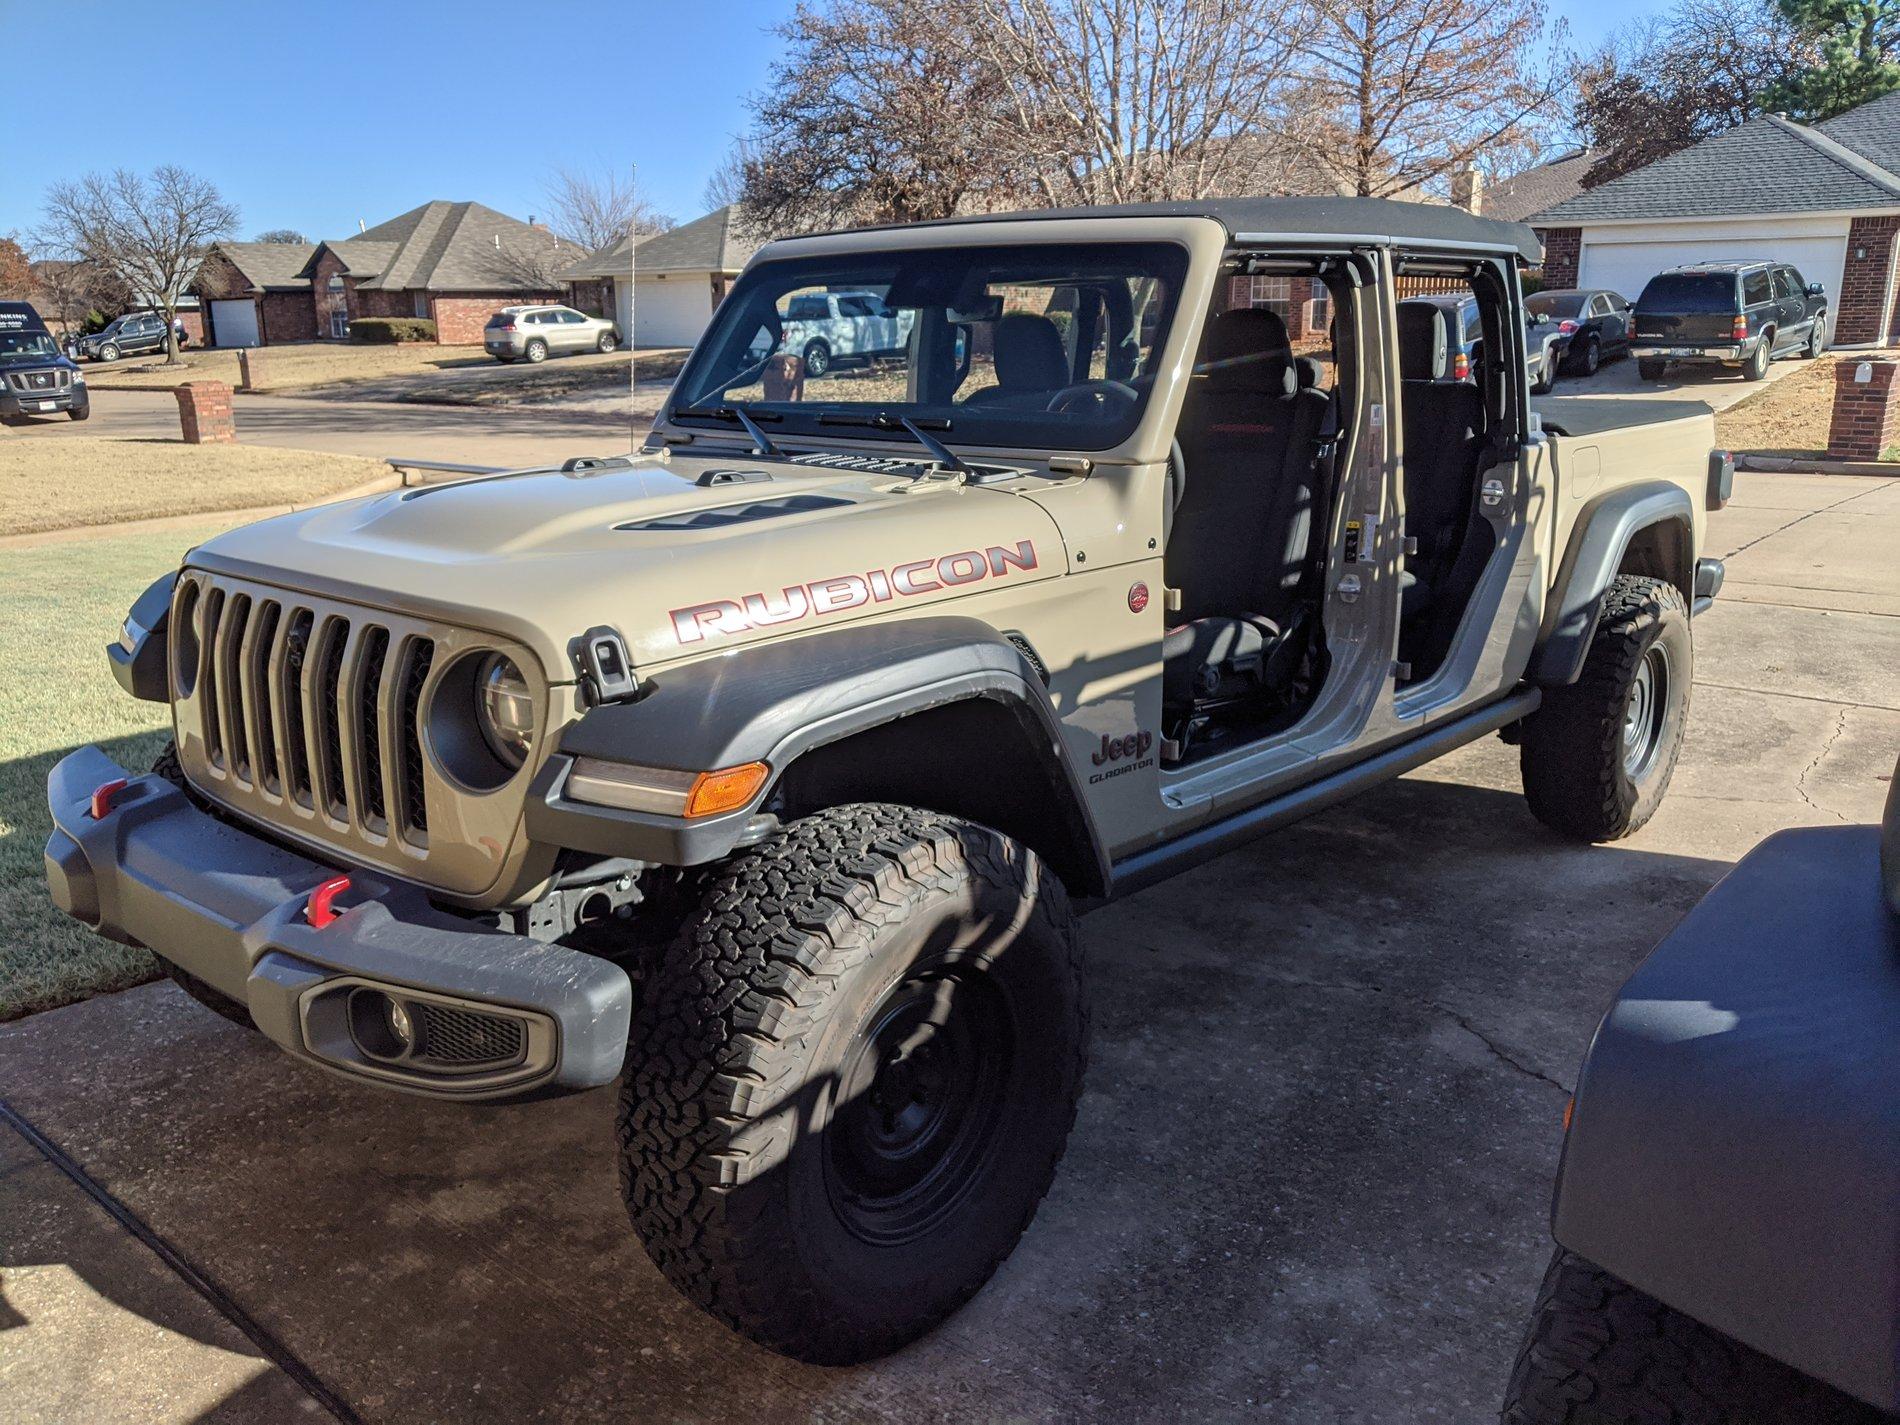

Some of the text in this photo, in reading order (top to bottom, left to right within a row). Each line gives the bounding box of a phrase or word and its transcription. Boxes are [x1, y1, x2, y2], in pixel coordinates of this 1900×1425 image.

[669, 540, 1038, 644] RUBICON
[1092, 731, 1152, 766] Jeep
[1089, 758, 1154, 784] GLADIATOR
